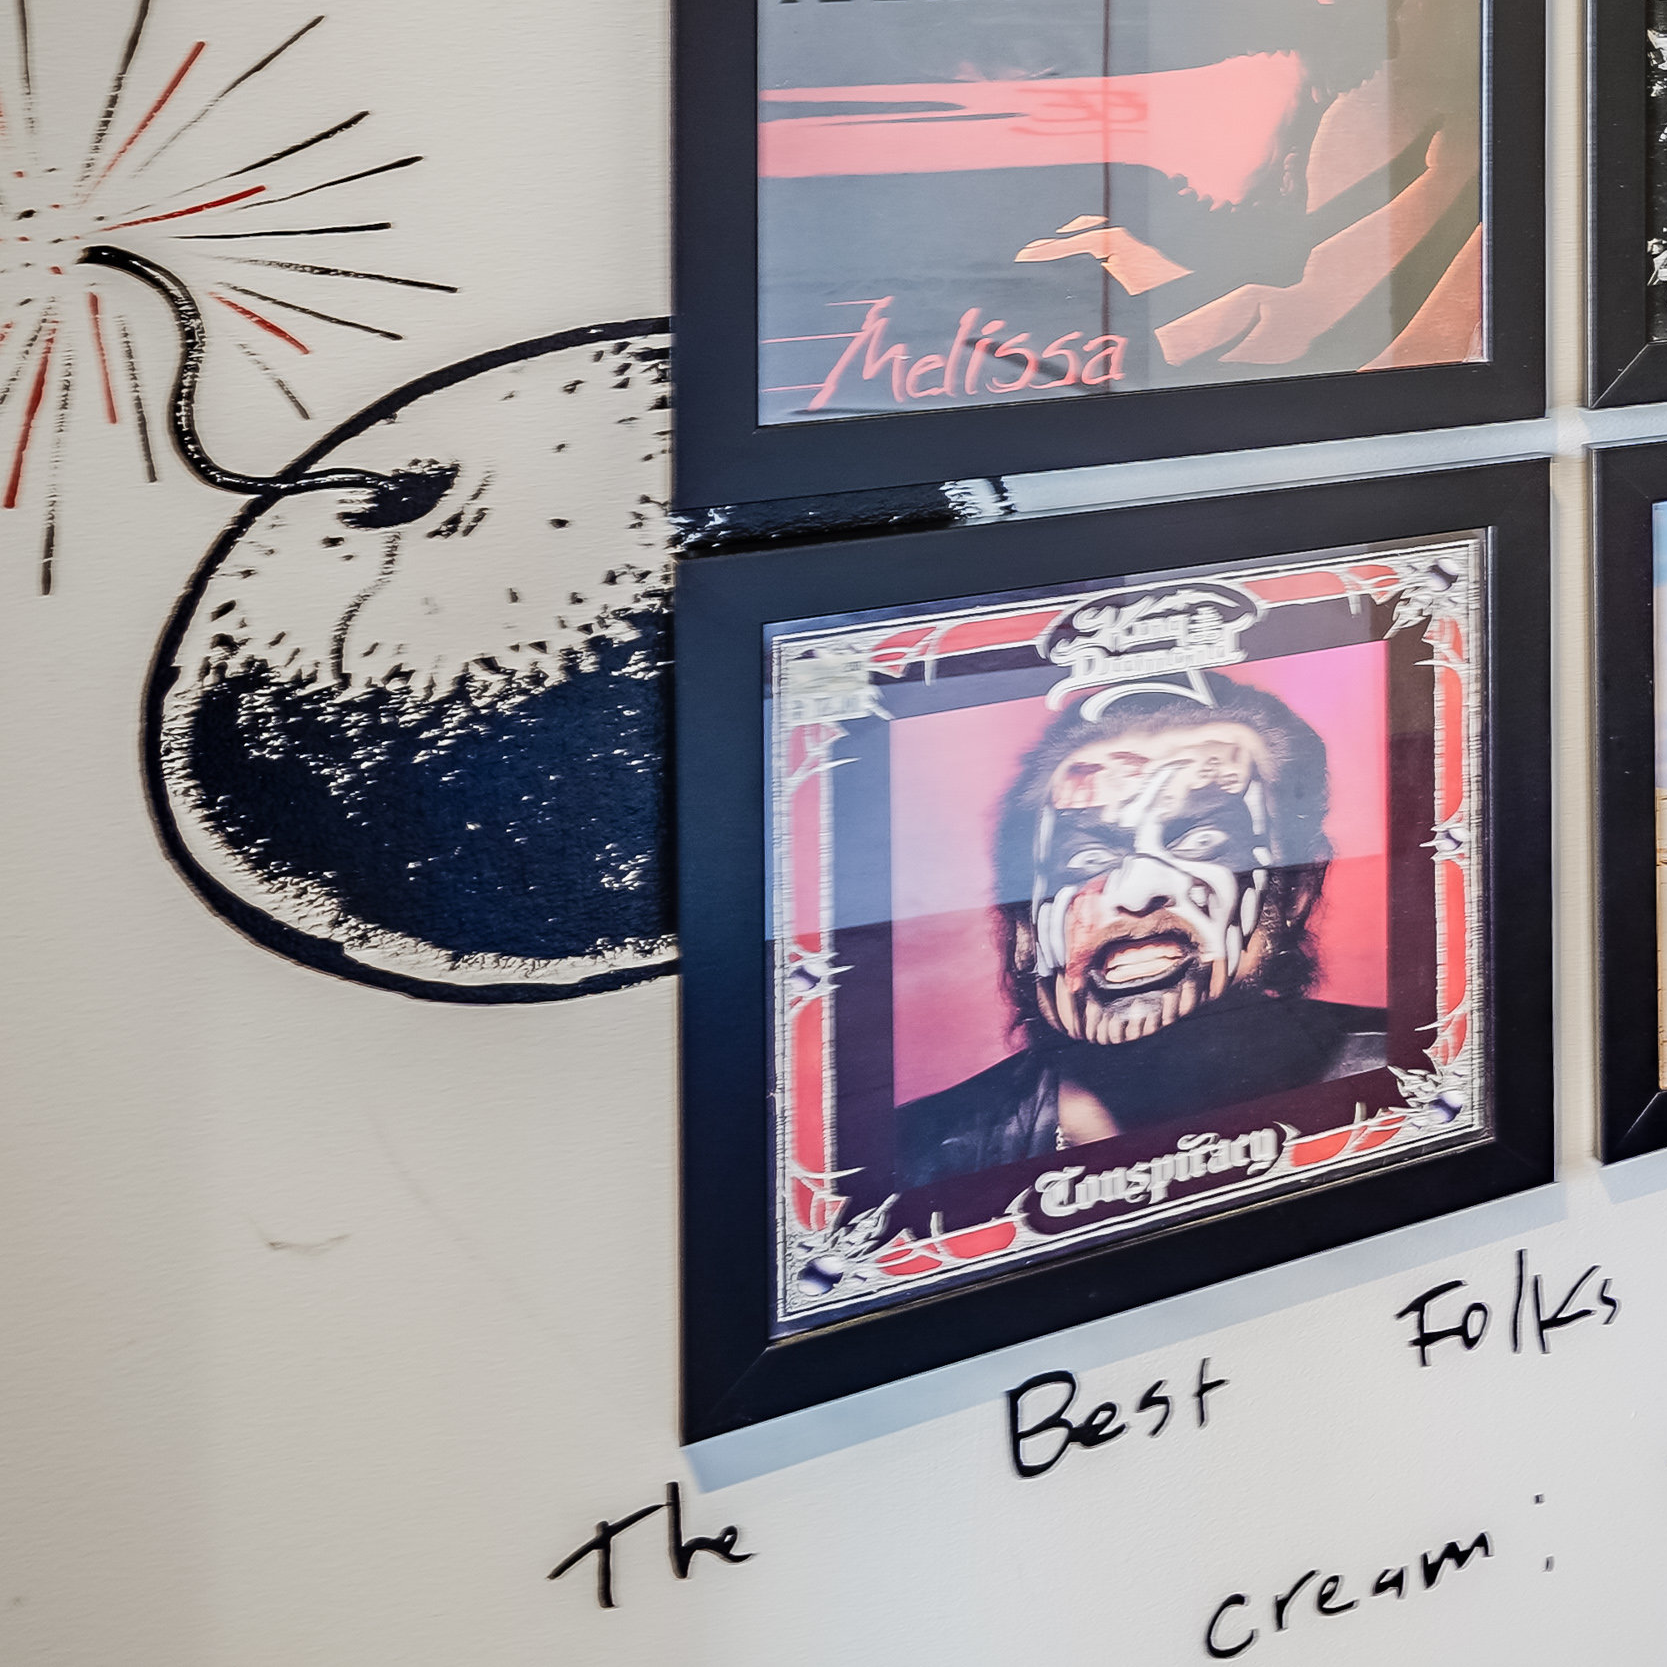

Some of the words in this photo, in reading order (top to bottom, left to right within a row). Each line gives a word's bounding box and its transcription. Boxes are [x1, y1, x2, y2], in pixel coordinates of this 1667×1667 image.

[808, 294, 1131, 412] Melissa
[547, 1481, 758, 1609] The
[1006, 1356, 1230, 1480] Best
